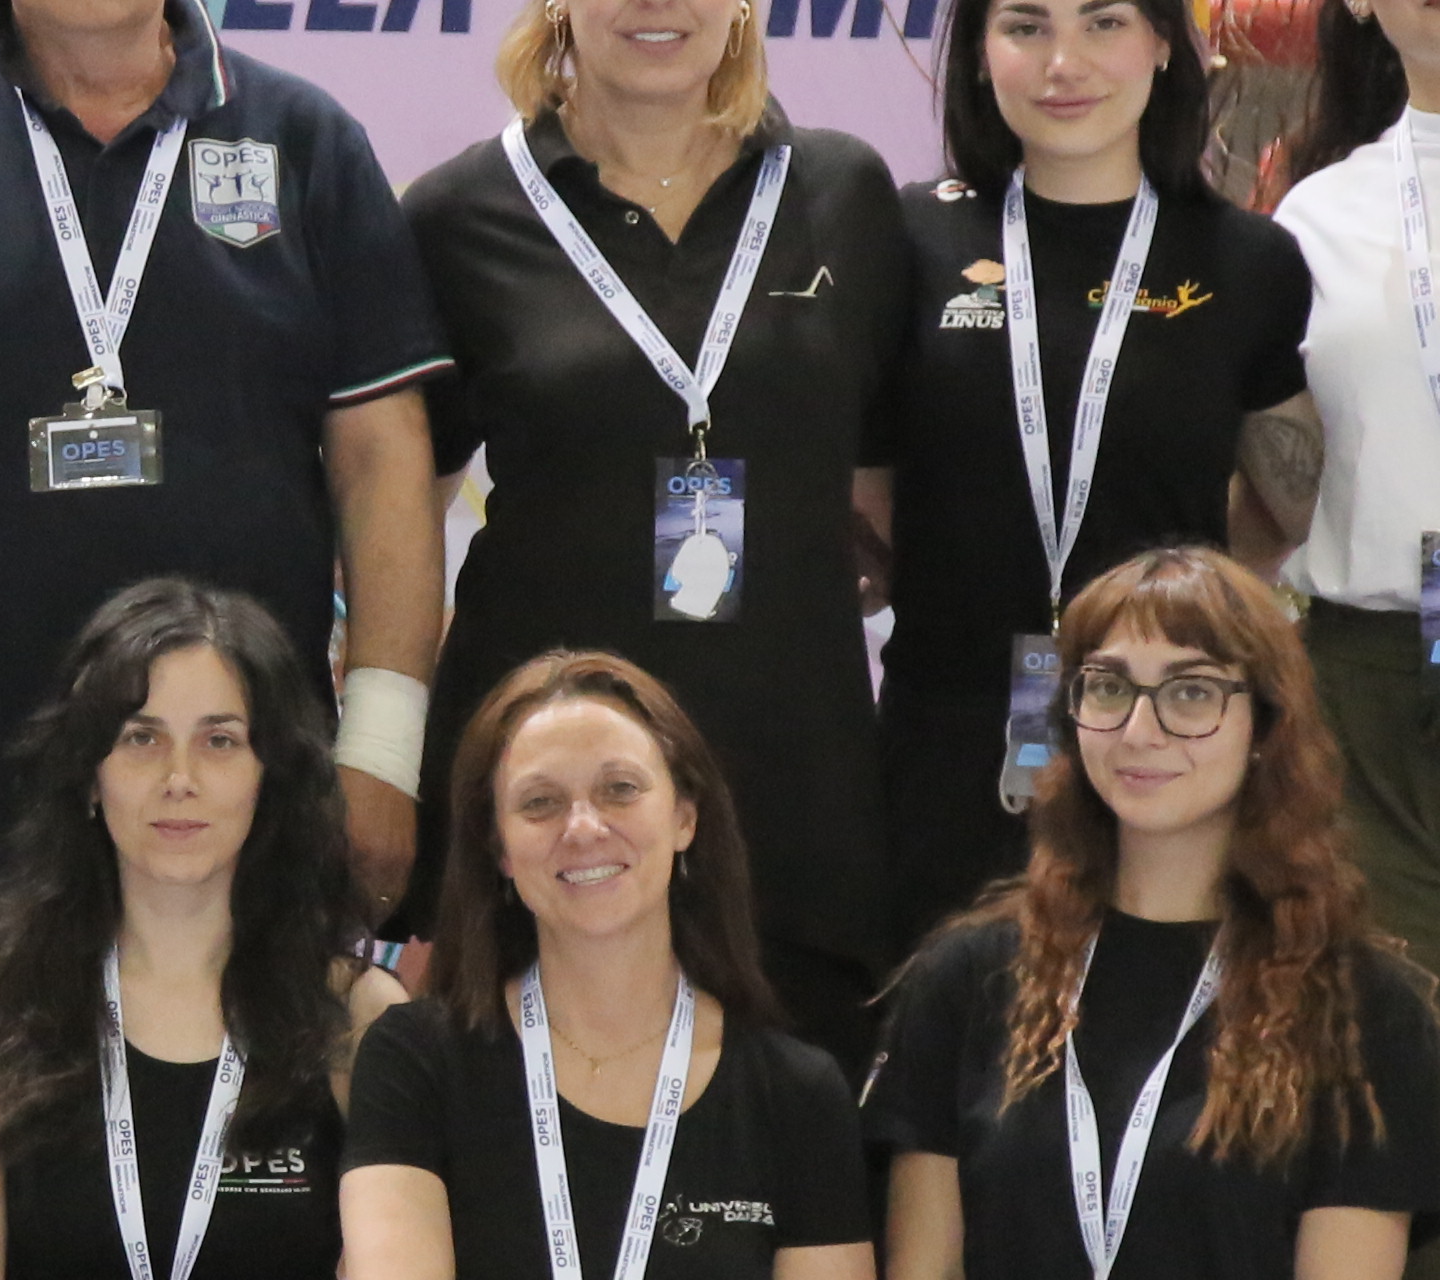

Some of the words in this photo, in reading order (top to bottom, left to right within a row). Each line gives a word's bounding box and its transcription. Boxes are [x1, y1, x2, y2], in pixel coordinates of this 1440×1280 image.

[202, 148, 268, 168] OPES
[149, 173, 165, 205] OPES
[527, 179, 549, 210] OPES
[1407, 177, 1420, 208] OPES
[54, 206, 72, 240] OPES
[749, 221, 767, 251] OPES
[588, 268, 615, 299] OPES
[1123, 263, 1141, 293] OPES
[1418, 267, 1432, 296] OPES
[119, 279, 136, 315] OPES
[1013, 290, 1024, 320] OPES
[86, 319, 105, 355] OPES
[716, 312, 735, 345] OPES
[939, 313, 1005, 329] LINUS
[657, 357, 685, 391] OPES
[1095, 359, 1113, 394] OPES
[1021, 397, 1035, 435] OPES
[62, 439, 125, 460] OPES
[523, 993, 535, 1028] OPES
[665, 1078, 682, 1116] OPES
[1132, 1090, 1151, 1128] OPES
[119, 1120, 133, 1156] OPES
[536, 1108, 550, 1146] OPES
[191, 1163, 209, 1200] OPES
[1085, 1171, 1098, 1211] OPES
[640, 1195, 656, 1231] OPES
[552, 1229, 567, 1268] OPES
